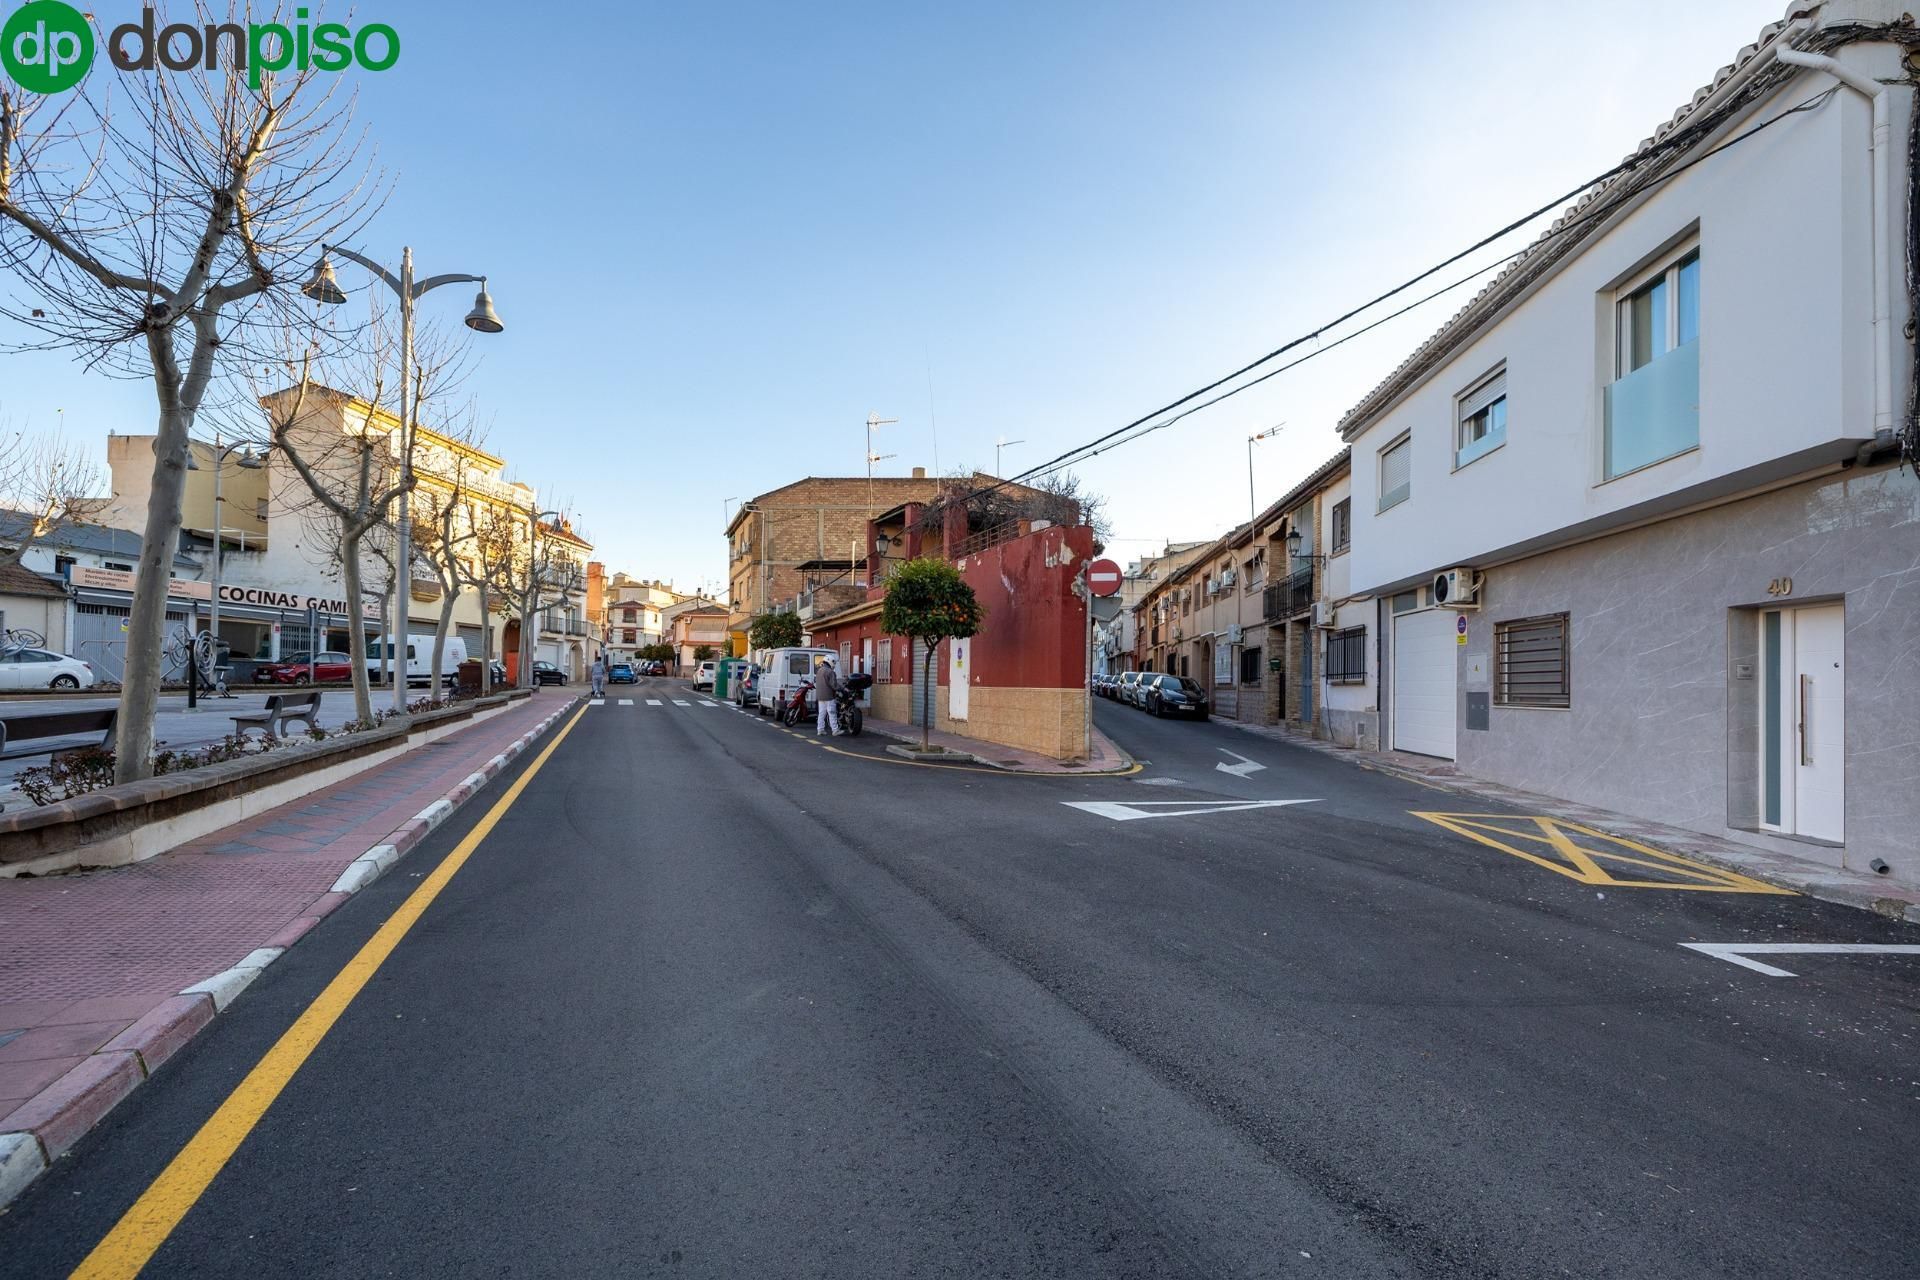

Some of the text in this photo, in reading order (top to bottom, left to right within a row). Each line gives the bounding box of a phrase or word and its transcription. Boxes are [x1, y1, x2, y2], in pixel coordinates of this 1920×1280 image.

[219, 585, 298, 608] COCINAS
[306, 597, 349, 613] GAMI
[1767, 577, 1793, 597] 40
